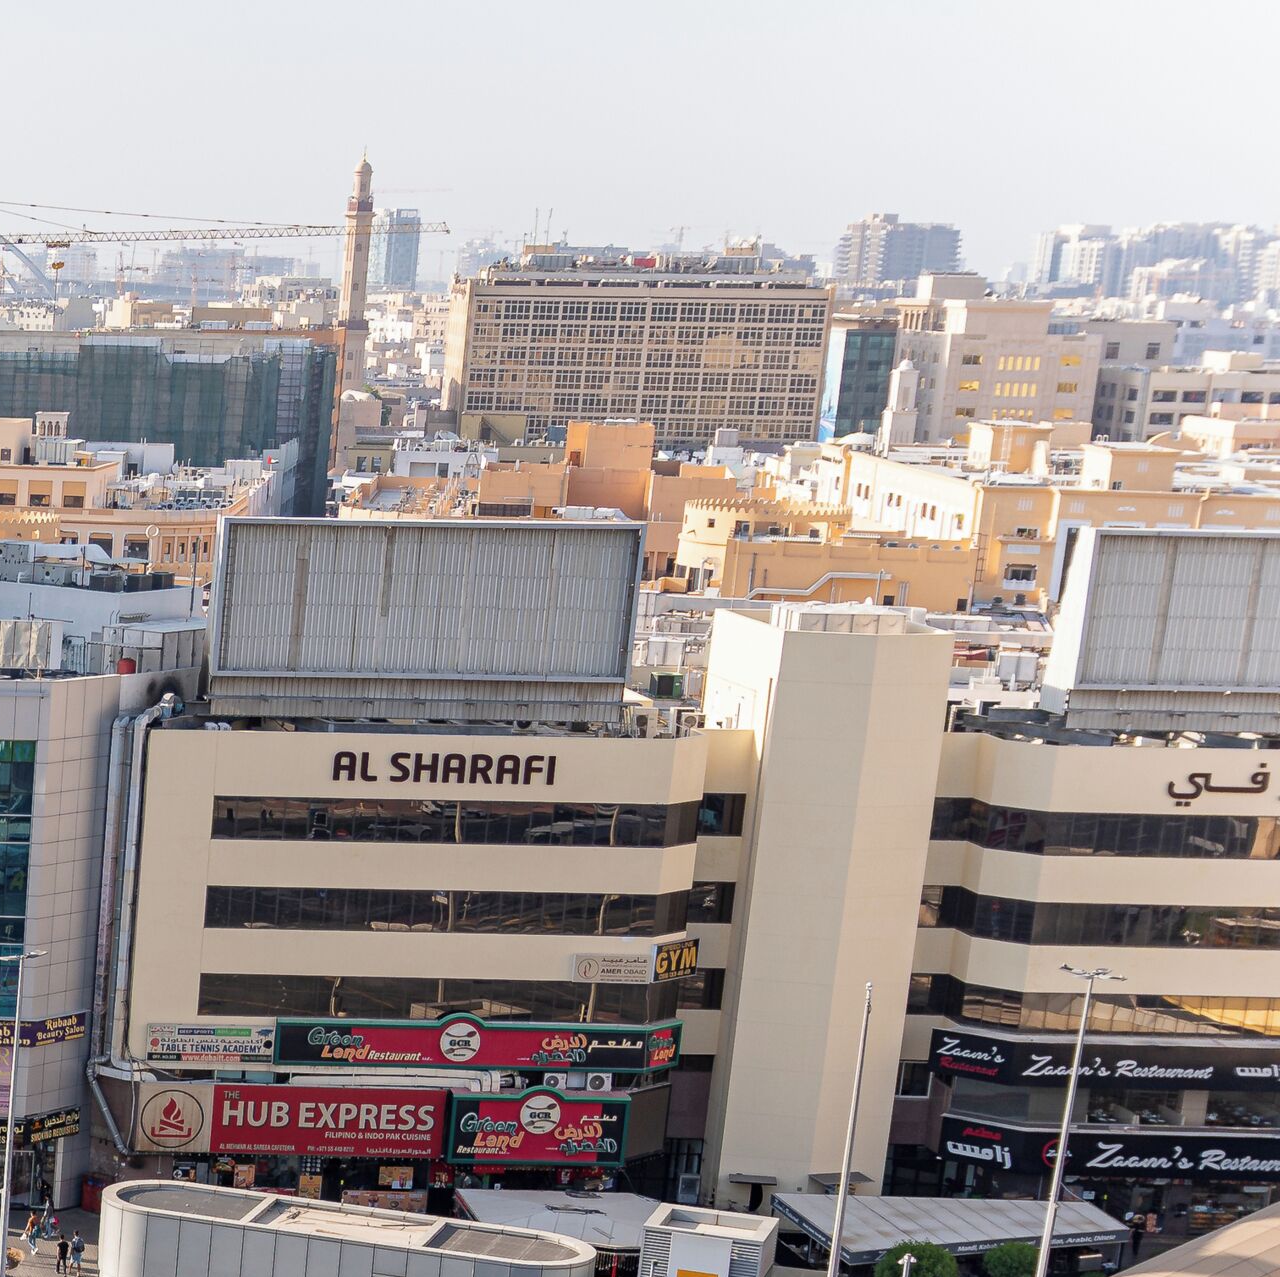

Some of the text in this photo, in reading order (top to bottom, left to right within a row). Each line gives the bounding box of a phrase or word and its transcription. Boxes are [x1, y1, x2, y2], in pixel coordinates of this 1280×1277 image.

[332, 751, 557, 785] AL SHARAFI
[655, 946, 697, 974] GYM
[44, 1015, 77, 1031] Rübaab
[36, 1025, 85, 1040] Beauty Salon
[307, 1026, 364, 1047] Green
[160, 1043, 263, 1053] TABLE TENNIS ACADEMY
[321, 1045, 422, 1062] Land Restaurant
[589, 1039, 644, 1053] مطعم
[653, 1044, 676, 1061] Land
[1115, 1059, 1214, 1079] Restaurant
[223, 1091, 240, 1099] THE
[222, 1100, 435, 1131] HUB EXPRESS
[460, 1112, 519, 1136] Green
[31, 1122, 80, 1142] SMOKING REQUISITES
[324, 1131, 357, 1139] FILIPINO
[365, 1132, 385, 1140] INDO
[385, 1132, 401, 1140] PAK
[401, 1133, 432, 1141] CUISINE
[456, 1145, 499, 1154] Restaurant
[473, 1131, 525, 1153] Land
[1086, 1142, 1194, 1168] Zaam's
